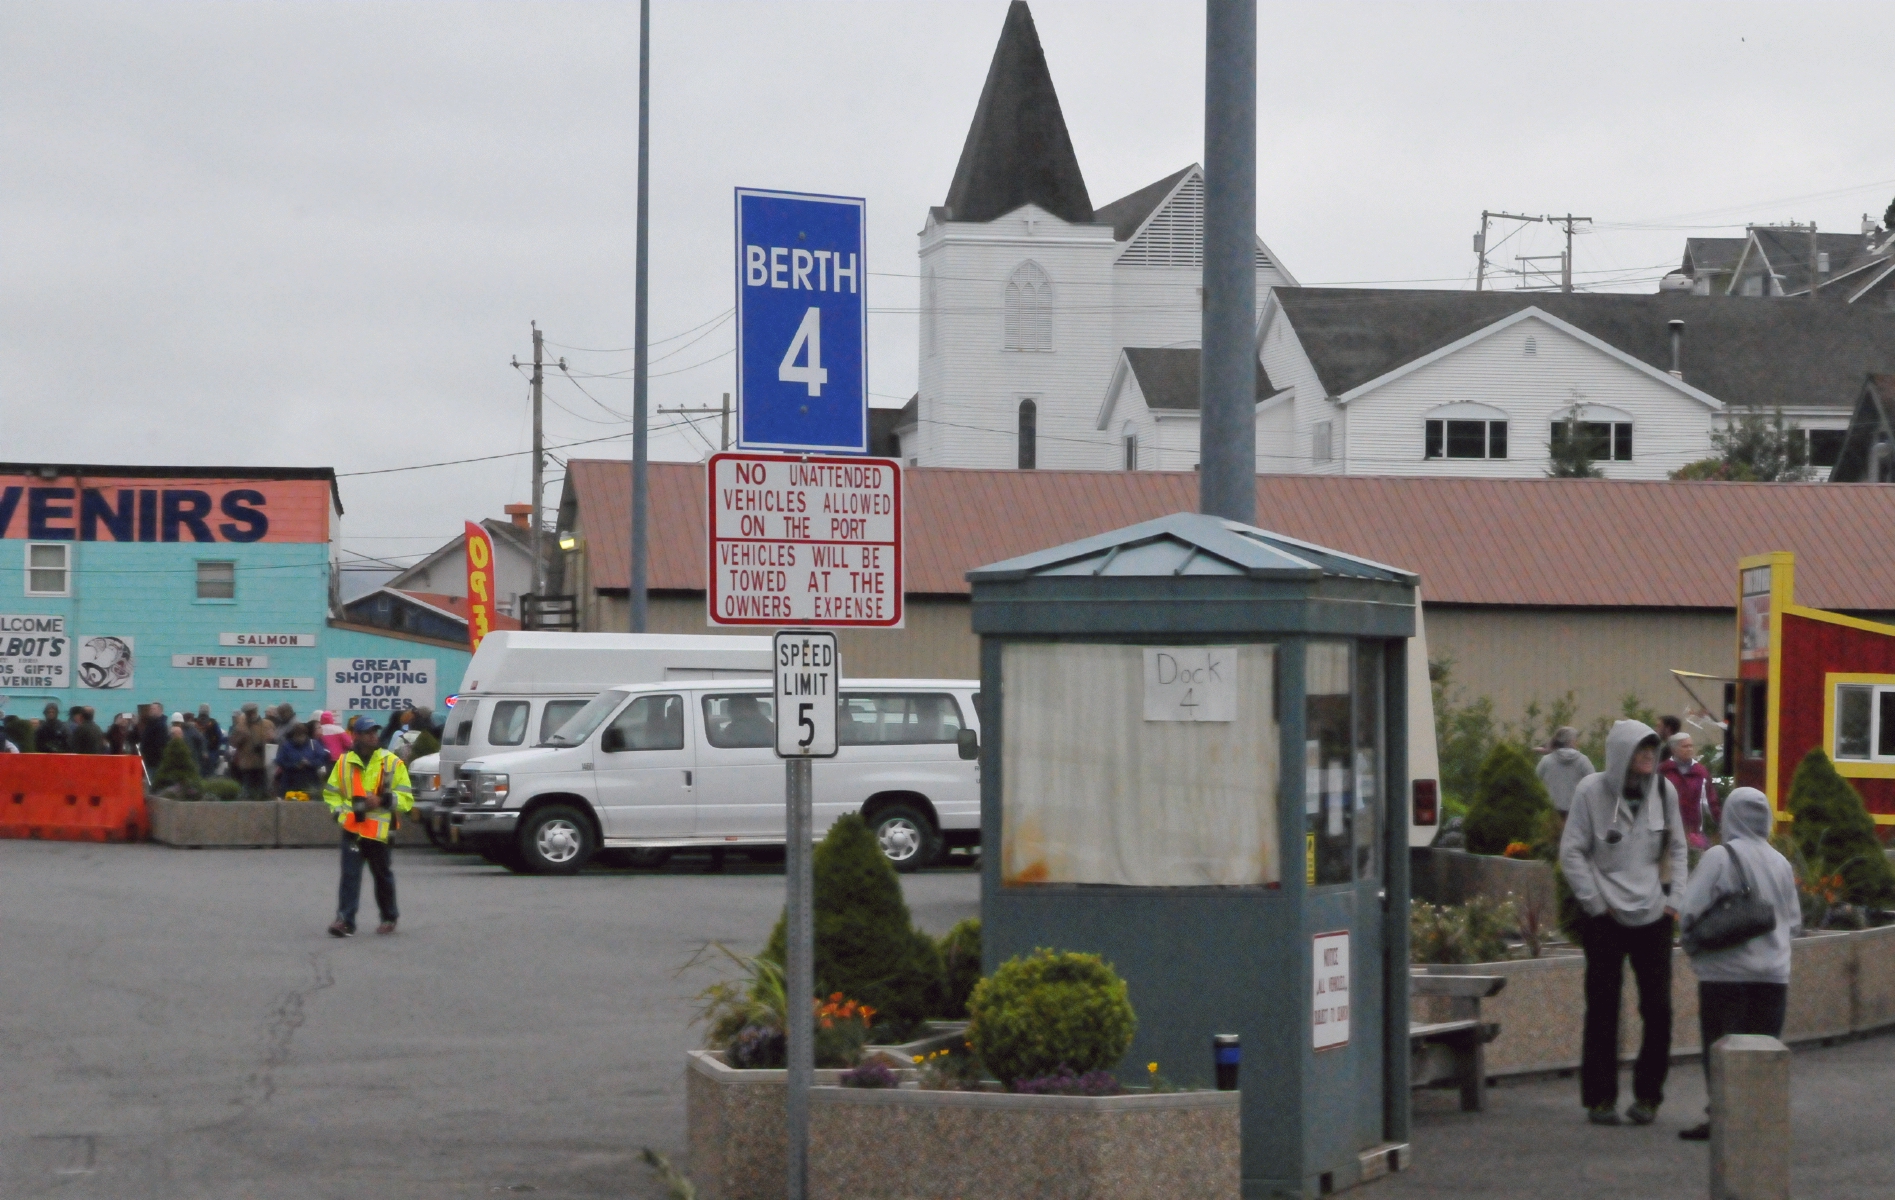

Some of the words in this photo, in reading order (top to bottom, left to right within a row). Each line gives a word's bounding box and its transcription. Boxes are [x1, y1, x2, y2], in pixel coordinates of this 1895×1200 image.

[746, 244, 857, 294] BERTH
[778, 306, 828, 397] 4
[735, 462, 767, 486] NO
[789, 465, 882, 489] UNATTENDED
[723, 489, 807, 513] VEHICLES
[823, 492, 891, 515] ALLOWED
[740, 514, 765, 537] ON
[783, 516, 811, 539] THE
[830, 517, 867, 540] PORT
[721, 543, 796, 567] VEHICLES
[812, 545, 849, 568] WILL
[862, 547, 881, 569] BE
[729, 569, 786, 592] TOWED
[807, 571, 831, 593] AT
[849, 572, 885, 594] THE
[725, 595, 792, 618] OWNERS
[814, 597, 884, 619] EXPENSE
[1, 617, 63, 632] LCOME
[237, 635, 298, 645] SALMON
[187, 656, 253, 667] JEWELRY
[352, 659, 411, 671] GREAT
[780, 643, 832, 668] SPEED
[24, 664, 63, 675] GIFTS
[335, 671, 428, 684] SHOPPING
[1157, 652, 1221, 685] Dock
[2, 676, 53, 687] VENIRS
[235, 678, 298, 689] APPAREL
[361, 685, 401, 697] LOW
[783, 673, 829, 696] LIMIT
[348, 698, 413, 710] PRICES
[1179, 687, 1200, 716] 4
[797, 702, 815, 747] 5
